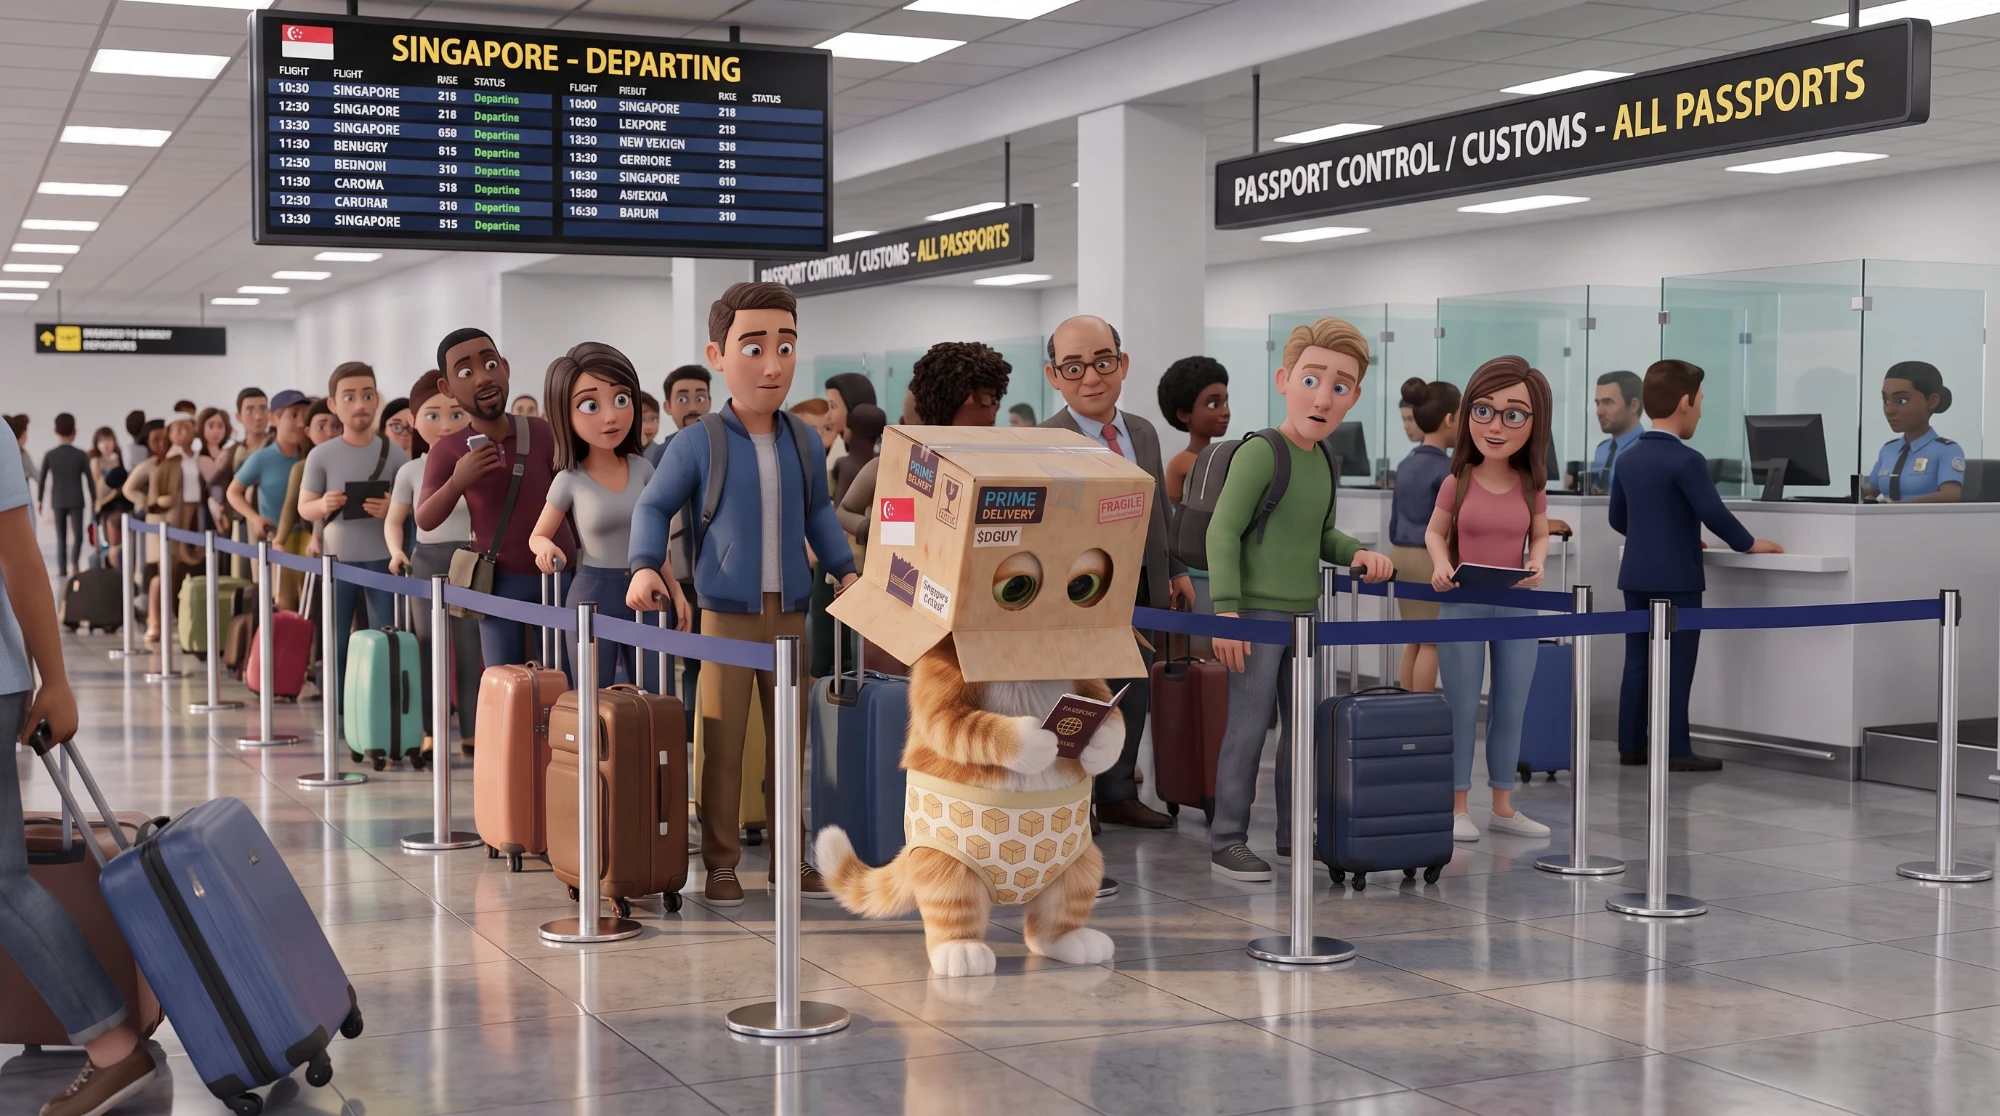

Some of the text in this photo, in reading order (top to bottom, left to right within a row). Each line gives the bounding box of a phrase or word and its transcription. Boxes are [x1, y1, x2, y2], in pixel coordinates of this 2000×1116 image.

[393, 35, 558, 71] SINGAPORE
[586, 47, 741, 83] DEPARTING
[280, 66, 309, 75] FLIGHT
[334, 69, 363, 78] FLIGHT
[475, 78, 505, 87] STATUS
[279, 82, 309, 93] 10:30
[334, 85, 399, 98] SINGAPORE
[570, 84, 597, 92] FLIGHT
[752, 94, 781, 103] STATUS
[279, 101, 309, 112] 12:30
[334, 103, 399, 116] SINGAPORE
[570, 99, 736, 117] 10:00 SINGAPORE 218
[279, 120, 309, 130] 13:30
[334, 122, 400, 135] SINGAPORE
[570, 117, 596, 127] 10:30
[1235, 160, 1332, 206] PASSPORT
[1336, 141, 1440, 188] CONTROL
[1445, 136, 1456, 171] /
[1462, 111, 1587, 167] CUSTOMS
[1613, 97, 1666, 140] ALL
[1676, 58, 1866, 129] PASSPORTS
[280, 139, 309, 149] 11:30
[620, 137, 644, 147] NEW
[570, 153, 597, 163] 13:30
[280, 176, 310, 186] 11:30
[335, 178, 384, 190] CAROMA
[620, 172, 679, 184] SINGAPORE
[280, 195, 310, 205] 12:30
[719, 194, 735, 203] 231
[570, 206, 597, 216] 16:30
[280, 214, 310, 224] 13:30
[335, 215, 400, 227] SINGAPORE
[761, 261, 807, 285] PASSPORT
[807, 252, 852, 282] CONTROL
[859, 242, 910, 273] CUSTOMS
[917, 237, 939, 263] ALL
[940, 223, 1010, 259] PASSPORTS
[910, 460, 934, 483] PRIME
[985, 491, 1037, 507] PRIME
[1101, 496, 1142, 513] FRAGILE
[982, 509, 1036, 520] DELIVERY
[977, 530, 1018, 544] $DGUY
